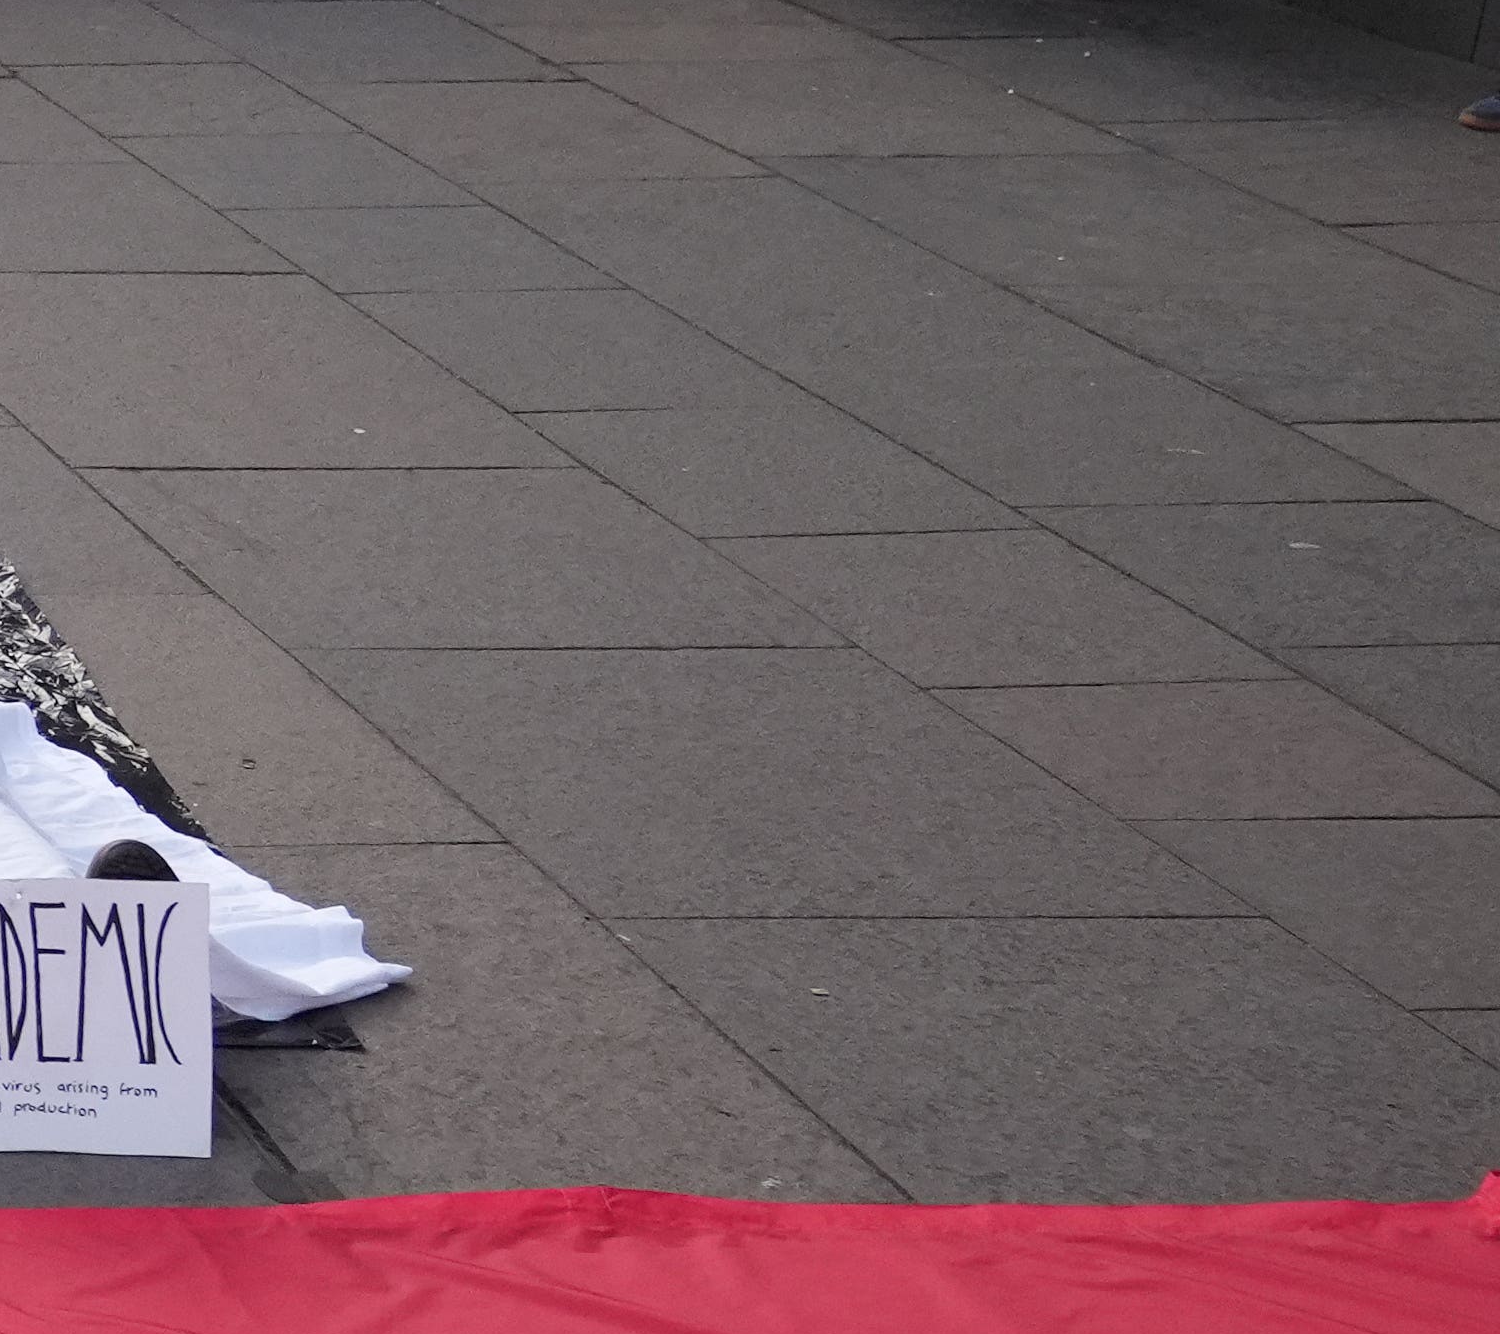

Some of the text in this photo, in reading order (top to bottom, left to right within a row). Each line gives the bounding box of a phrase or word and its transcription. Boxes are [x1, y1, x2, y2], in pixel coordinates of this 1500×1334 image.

[1, 1077, 42, 1095] virus
[56, 1078, 109, 1100] arising
[118, 1082, 159, 1098] from
[12, 1101, 99, 1119] production
